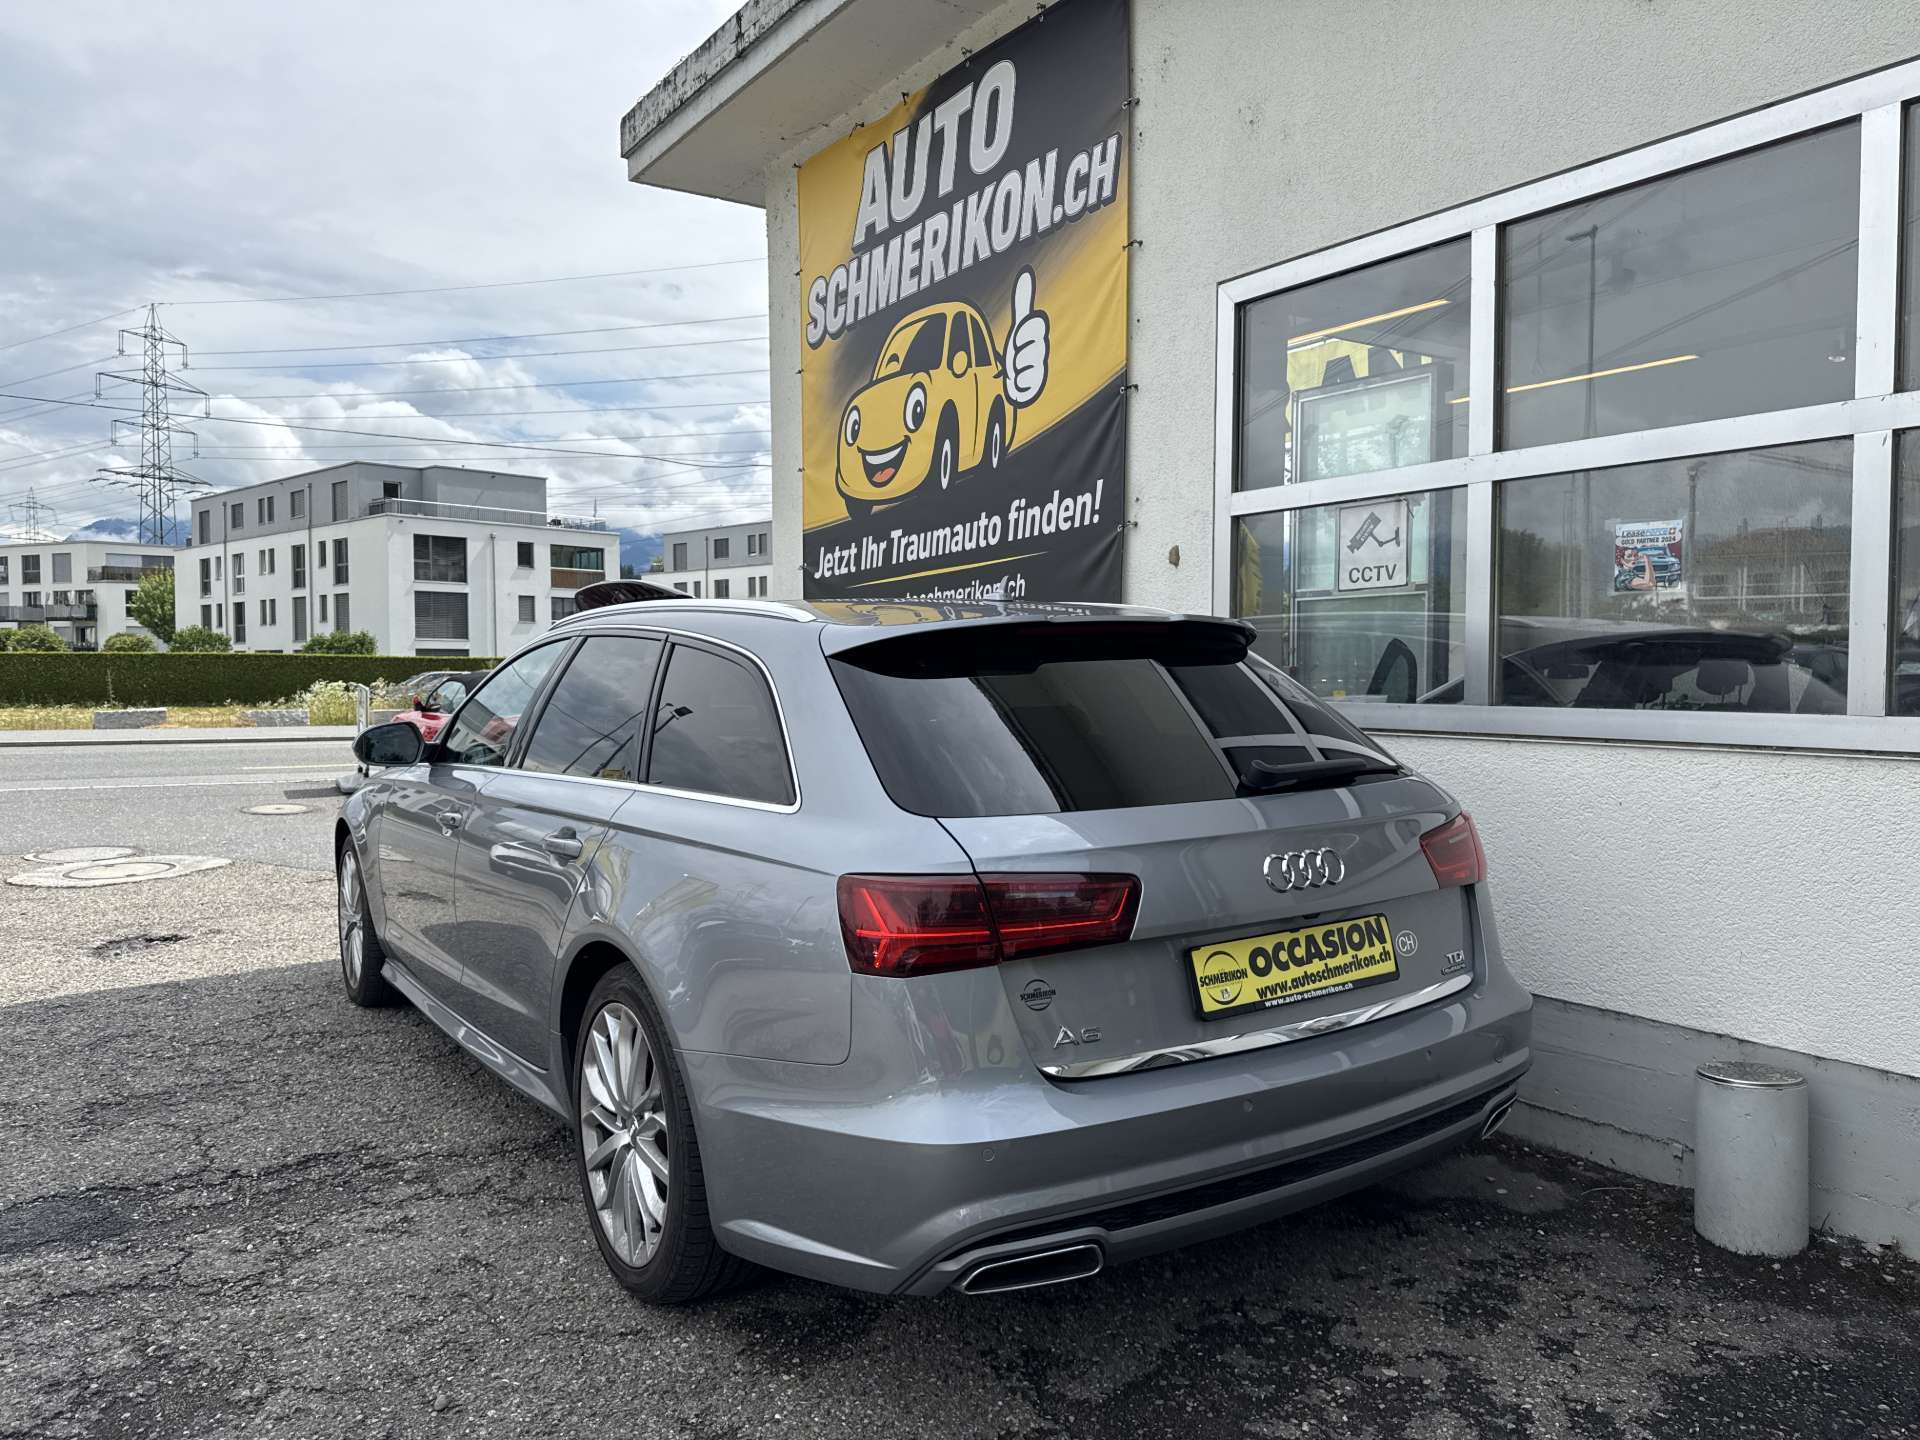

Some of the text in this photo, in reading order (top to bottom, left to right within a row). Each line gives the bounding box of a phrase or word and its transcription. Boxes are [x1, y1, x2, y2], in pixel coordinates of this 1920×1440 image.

[852, 59, 1016, 248] AUTO
[806, 134, 1118, 345] SCHMERIKON.CH
[814, 479, 1104, 579] Jetzt Ihr Traumauto finden!
[1349, 563, 1397, 584] CCTV
[1249, 919, 1387, 977] OCCASION
[1398, 934, 1415, 952] CH
[1446, 950, 1465, 964] TDI
[1199, 968, 1248, 988] SCHMERIKON
[1256, 945, 1392, 1000] www.autoschmerikon.ch
[1264, 982, 1354, 1008] www.auto-schmerikon.ch
[1053, 1024, 1102, 1049] A6
